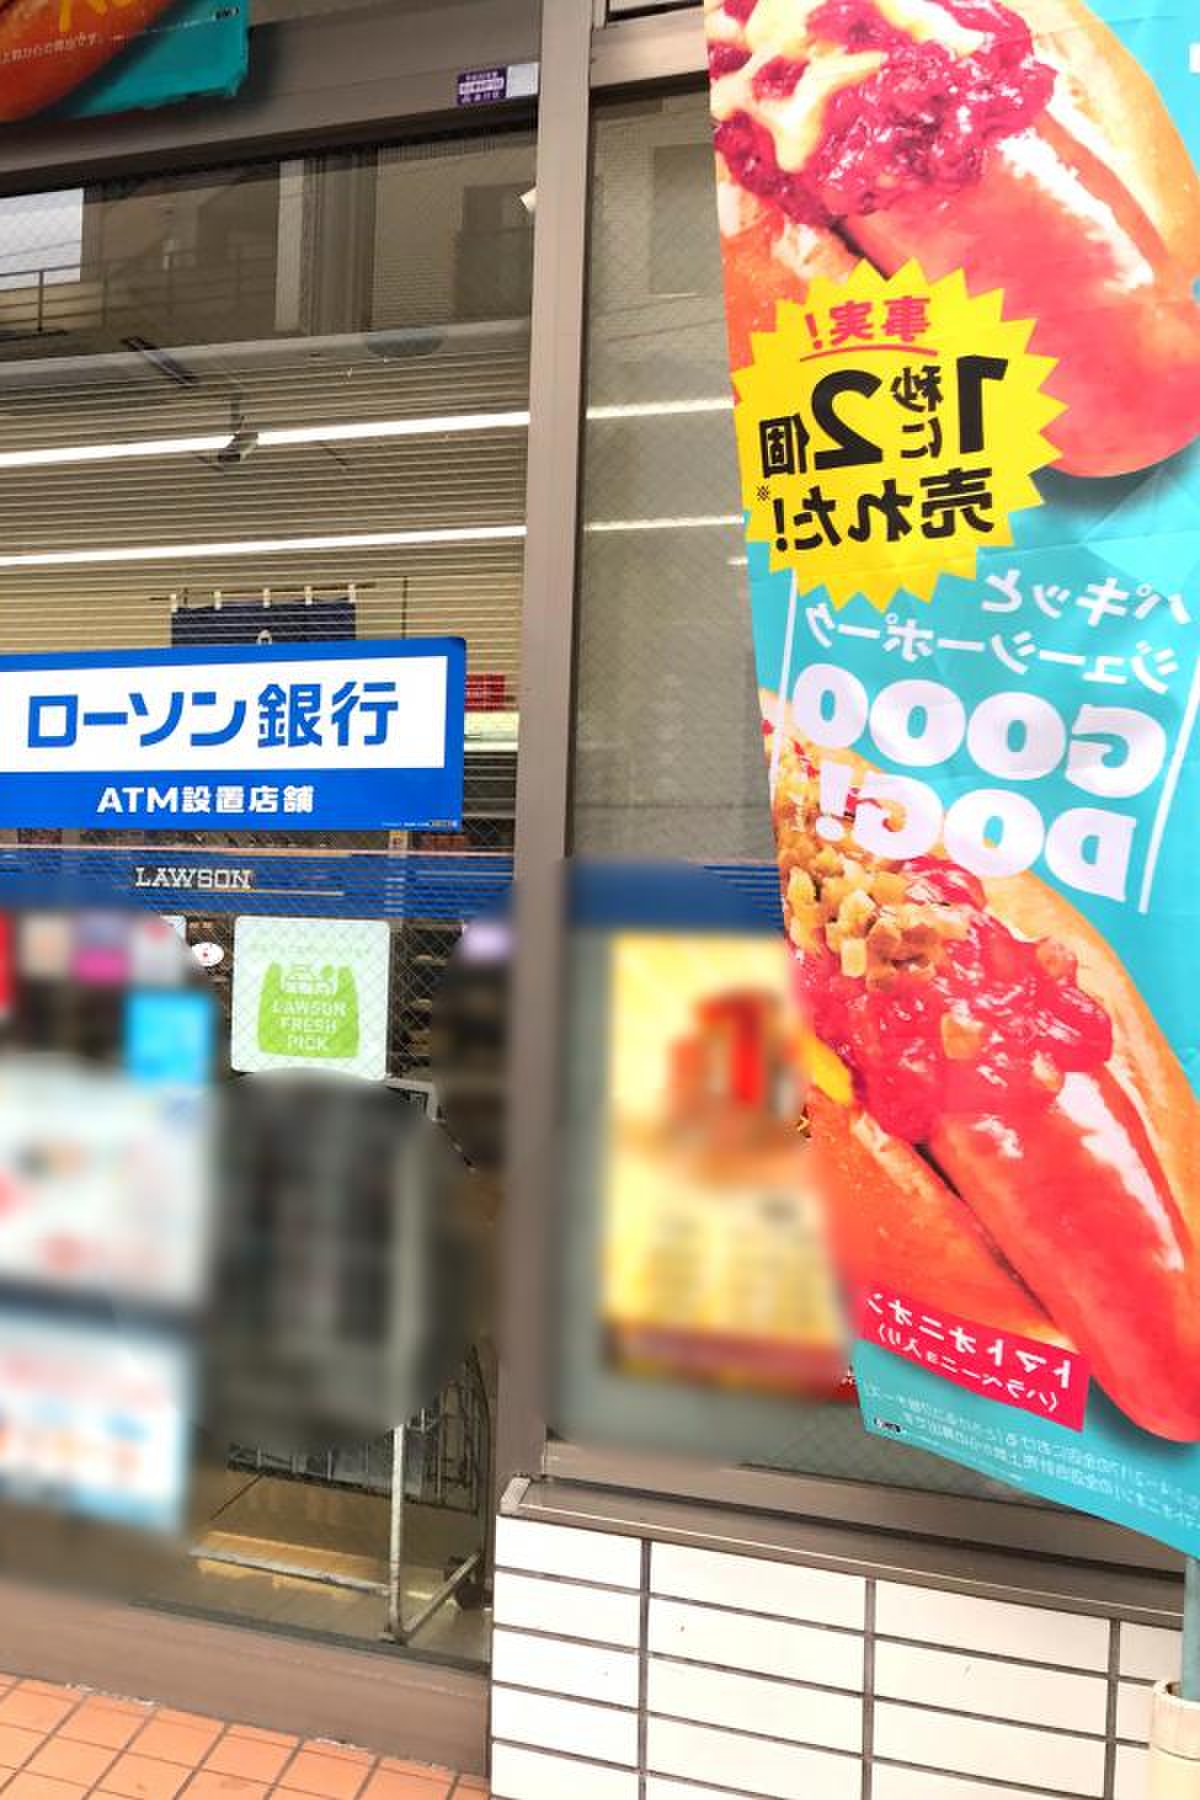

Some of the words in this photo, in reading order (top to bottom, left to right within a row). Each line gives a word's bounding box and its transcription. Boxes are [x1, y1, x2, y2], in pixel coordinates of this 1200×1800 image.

[27, 680, 399, 749] ローソン銀行
[96, 785, 314, 815] ATM設置店舗
[135, 866, 252, 890] LAWSON
